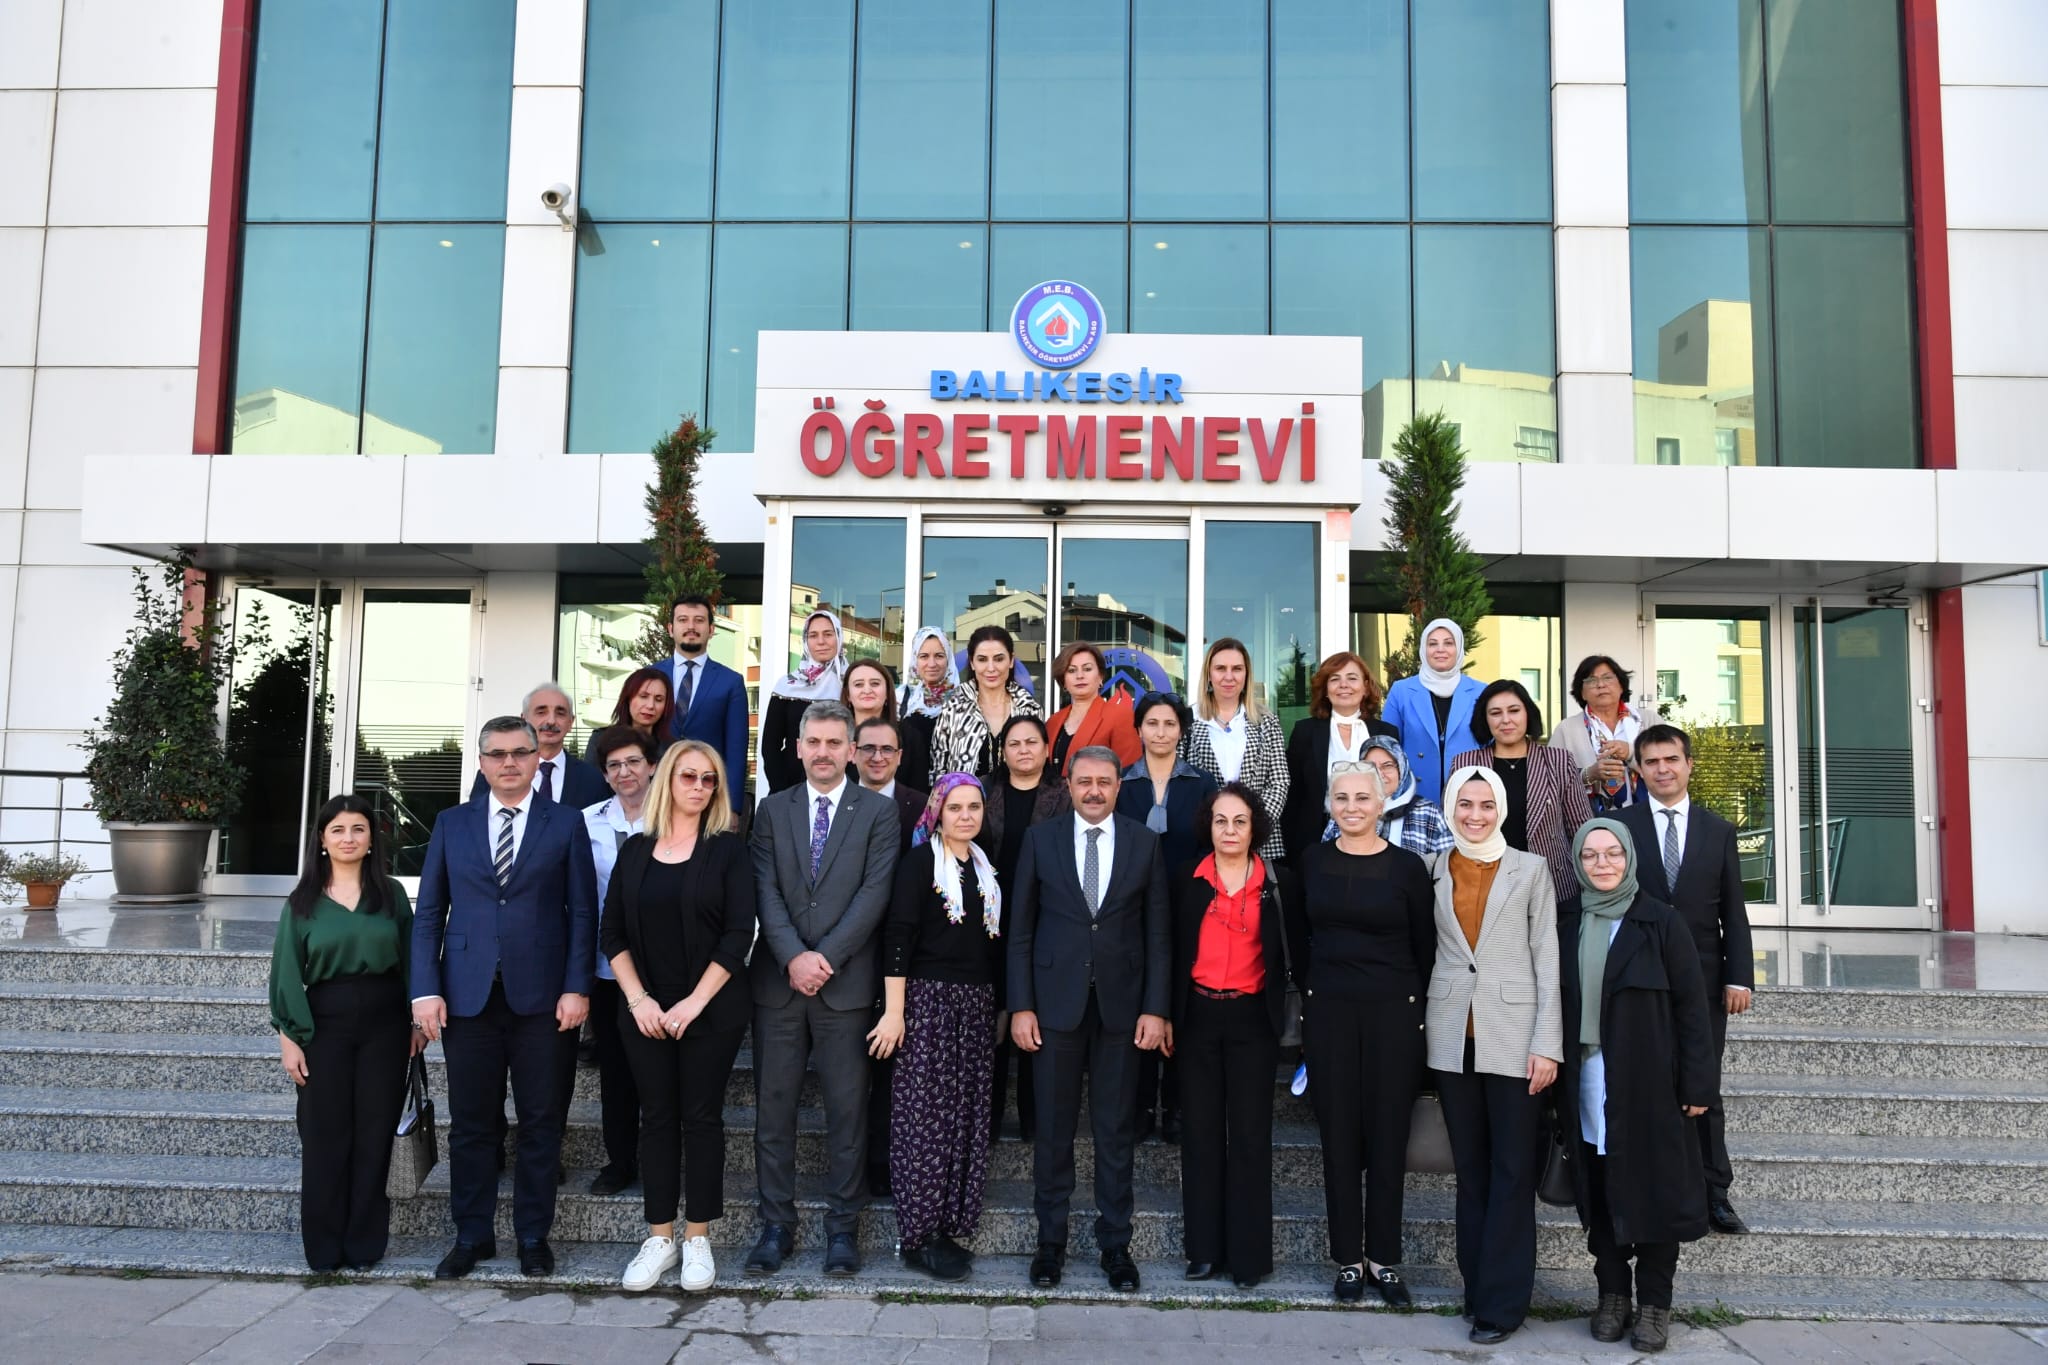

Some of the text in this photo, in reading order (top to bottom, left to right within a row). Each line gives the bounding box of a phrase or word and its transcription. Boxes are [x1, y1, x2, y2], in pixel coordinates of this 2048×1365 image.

[1043, 285, 1074, 295] M.E.B.
[929, 367, 1184, 404] BALIKESİR
[799, 396, 1316, 483] ÖĞRETMENEVİ
